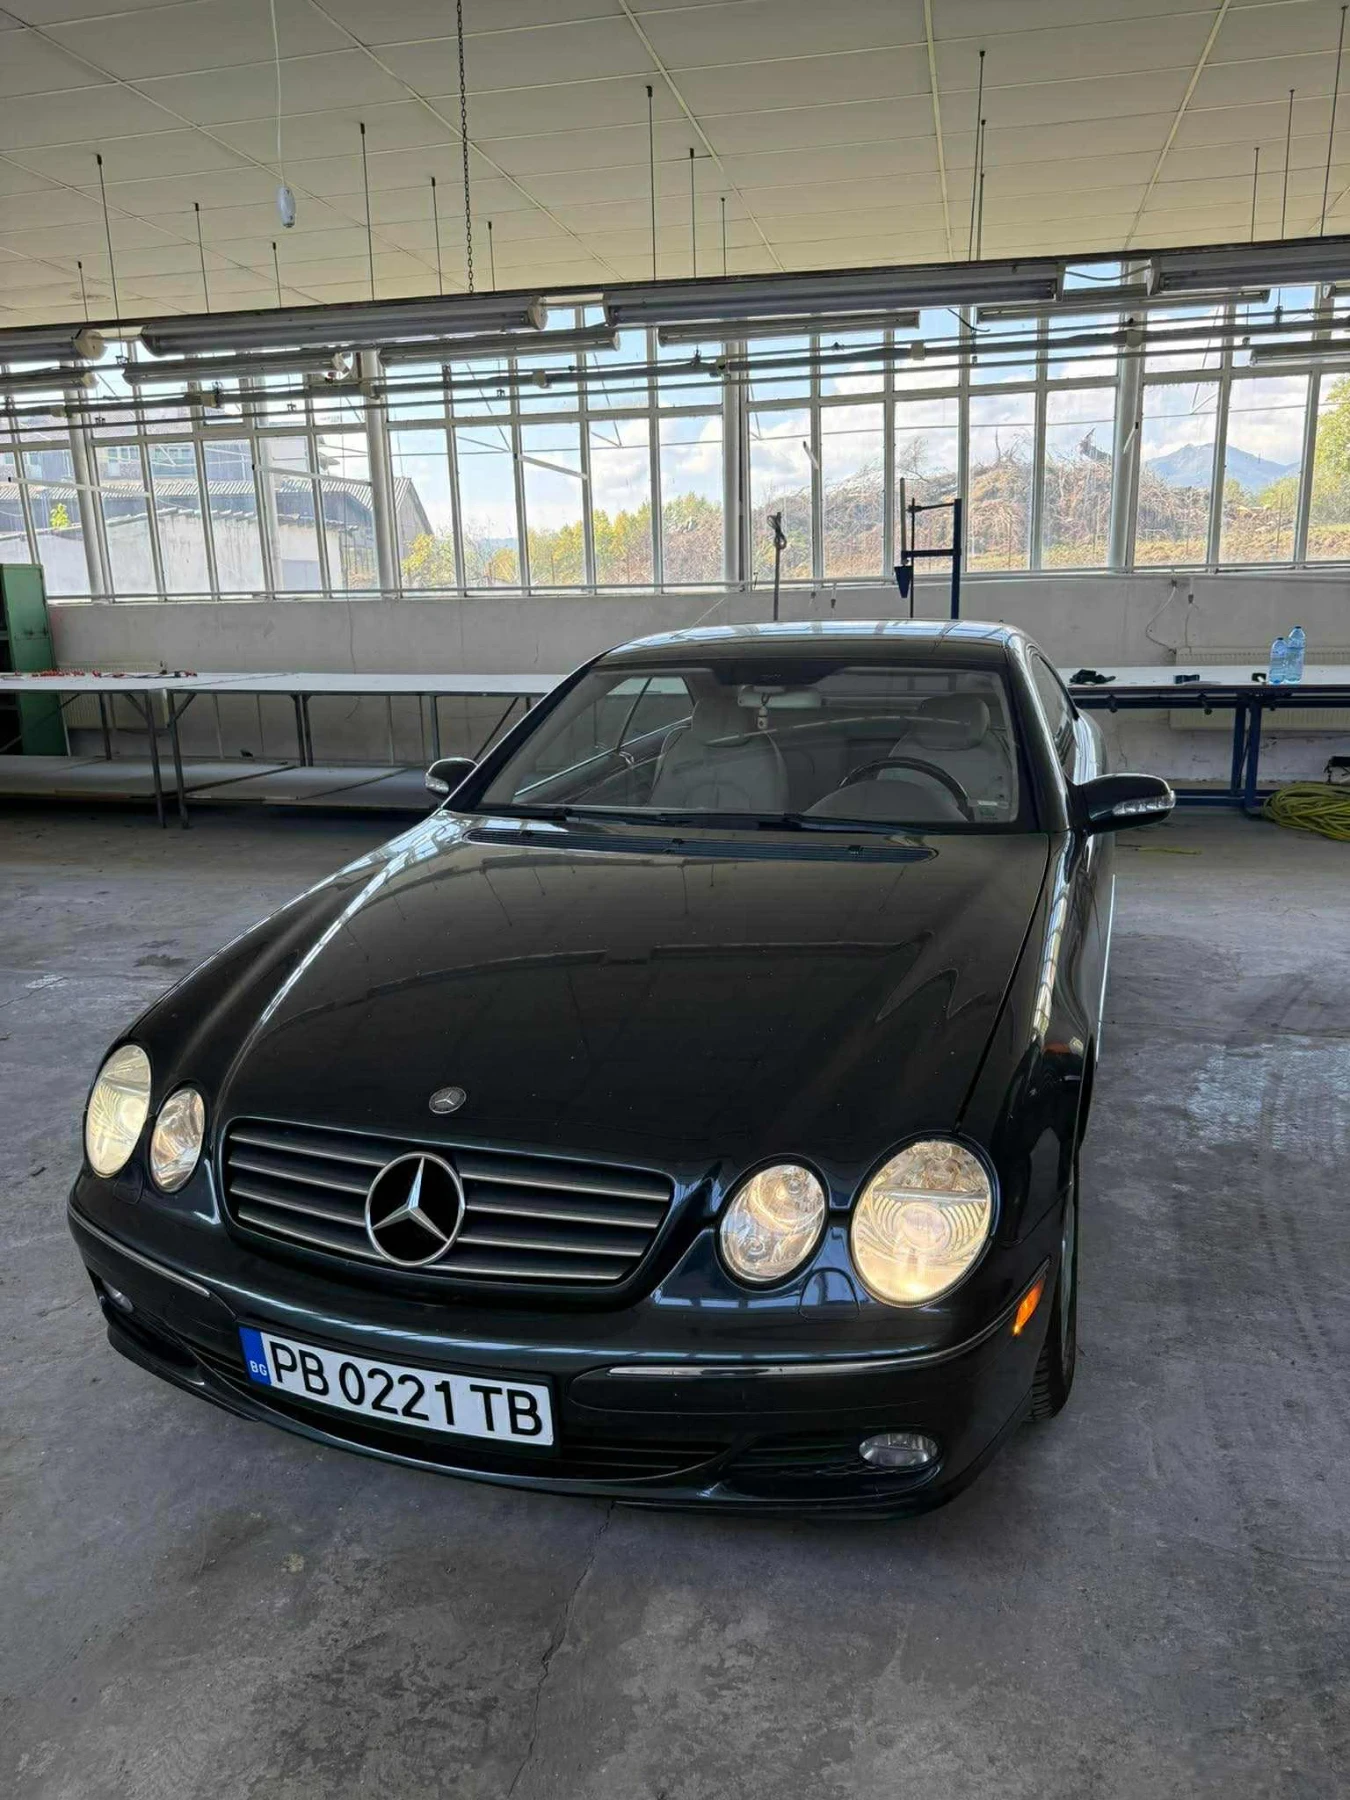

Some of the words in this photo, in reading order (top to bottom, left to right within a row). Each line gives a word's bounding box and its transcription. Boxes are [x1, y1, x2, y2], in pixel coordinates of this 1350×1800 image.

[249, 1361, 268, 1377] BG
[269, 1341, 330, 1396] PB
[338, 1362, 455, 1426] 0221
[469, 1384, 543, 1437] TB
